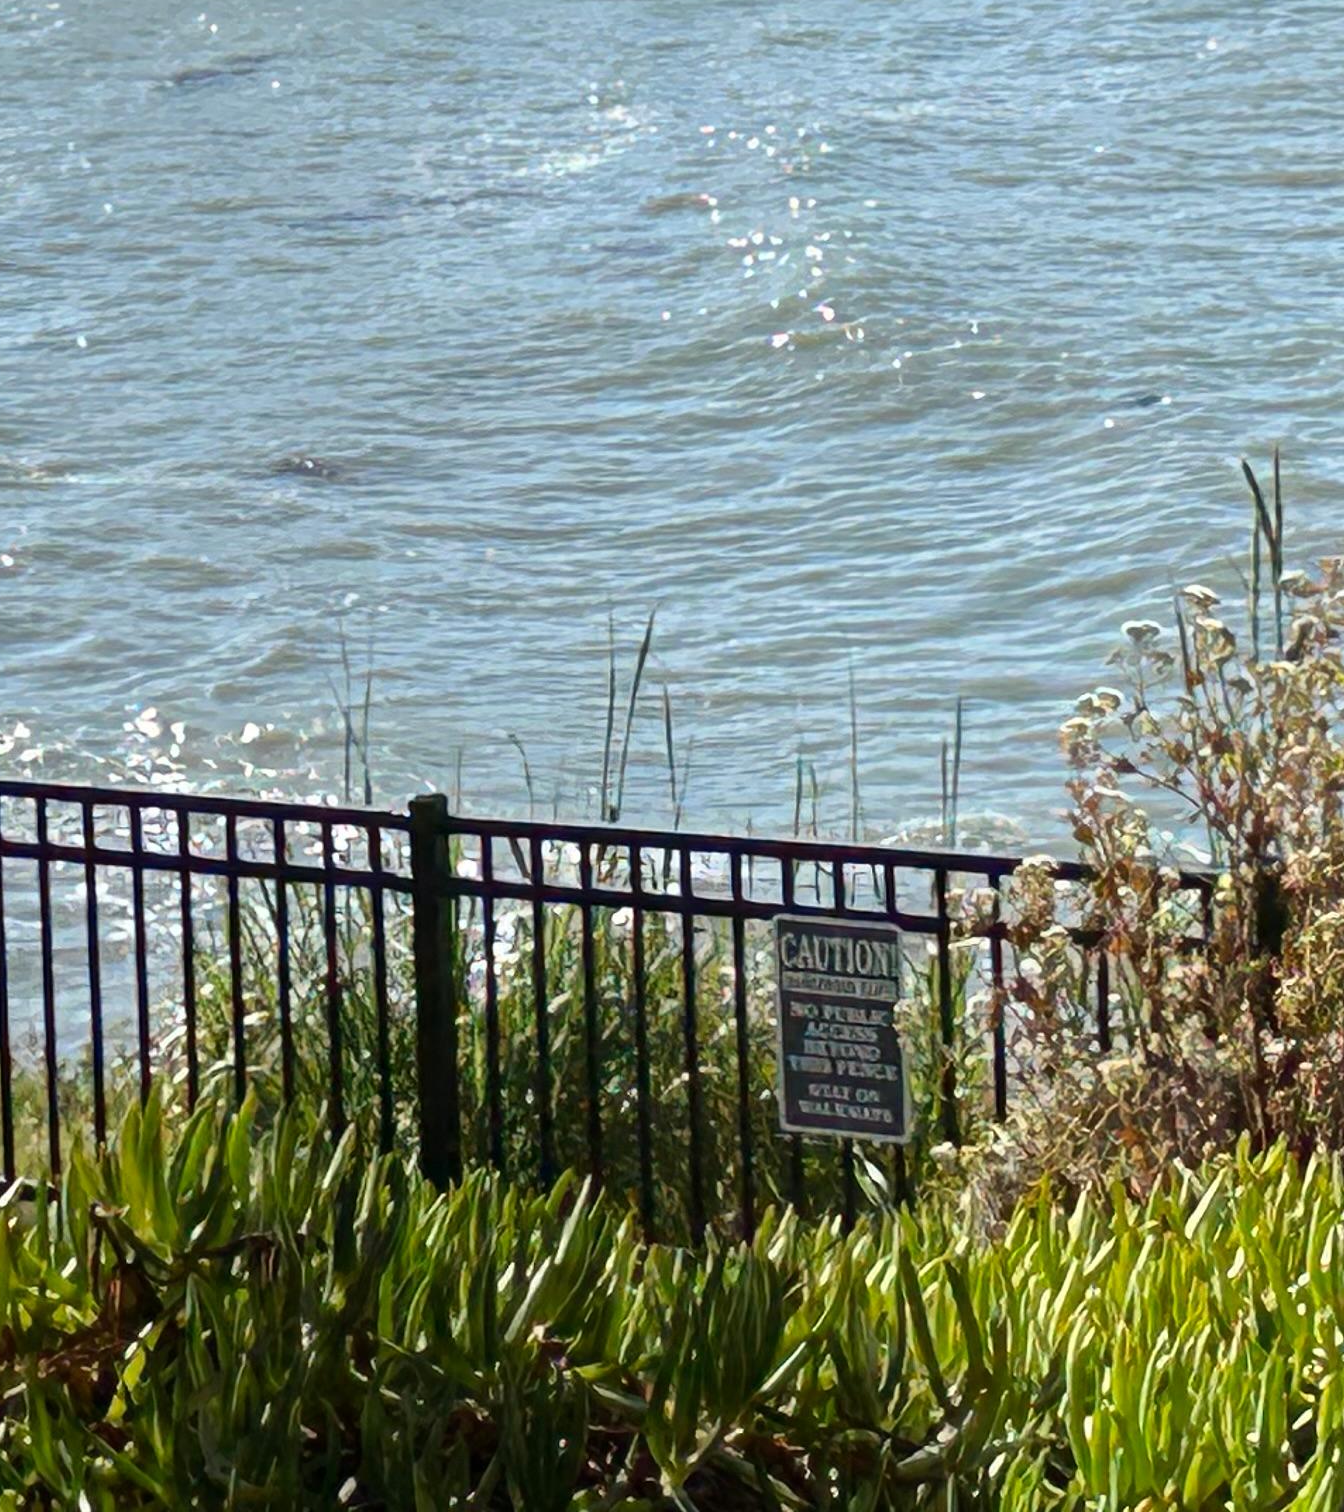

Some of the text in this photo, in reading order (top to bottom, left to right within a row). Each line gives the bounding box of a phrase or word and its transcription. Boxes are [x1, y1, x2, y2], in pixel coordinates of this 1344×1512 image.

[781, 932, 897, 977] CAUTION!
[790, 1001, 818, 1018] NO
[804, 1021, 878, 1042] ACCESS
